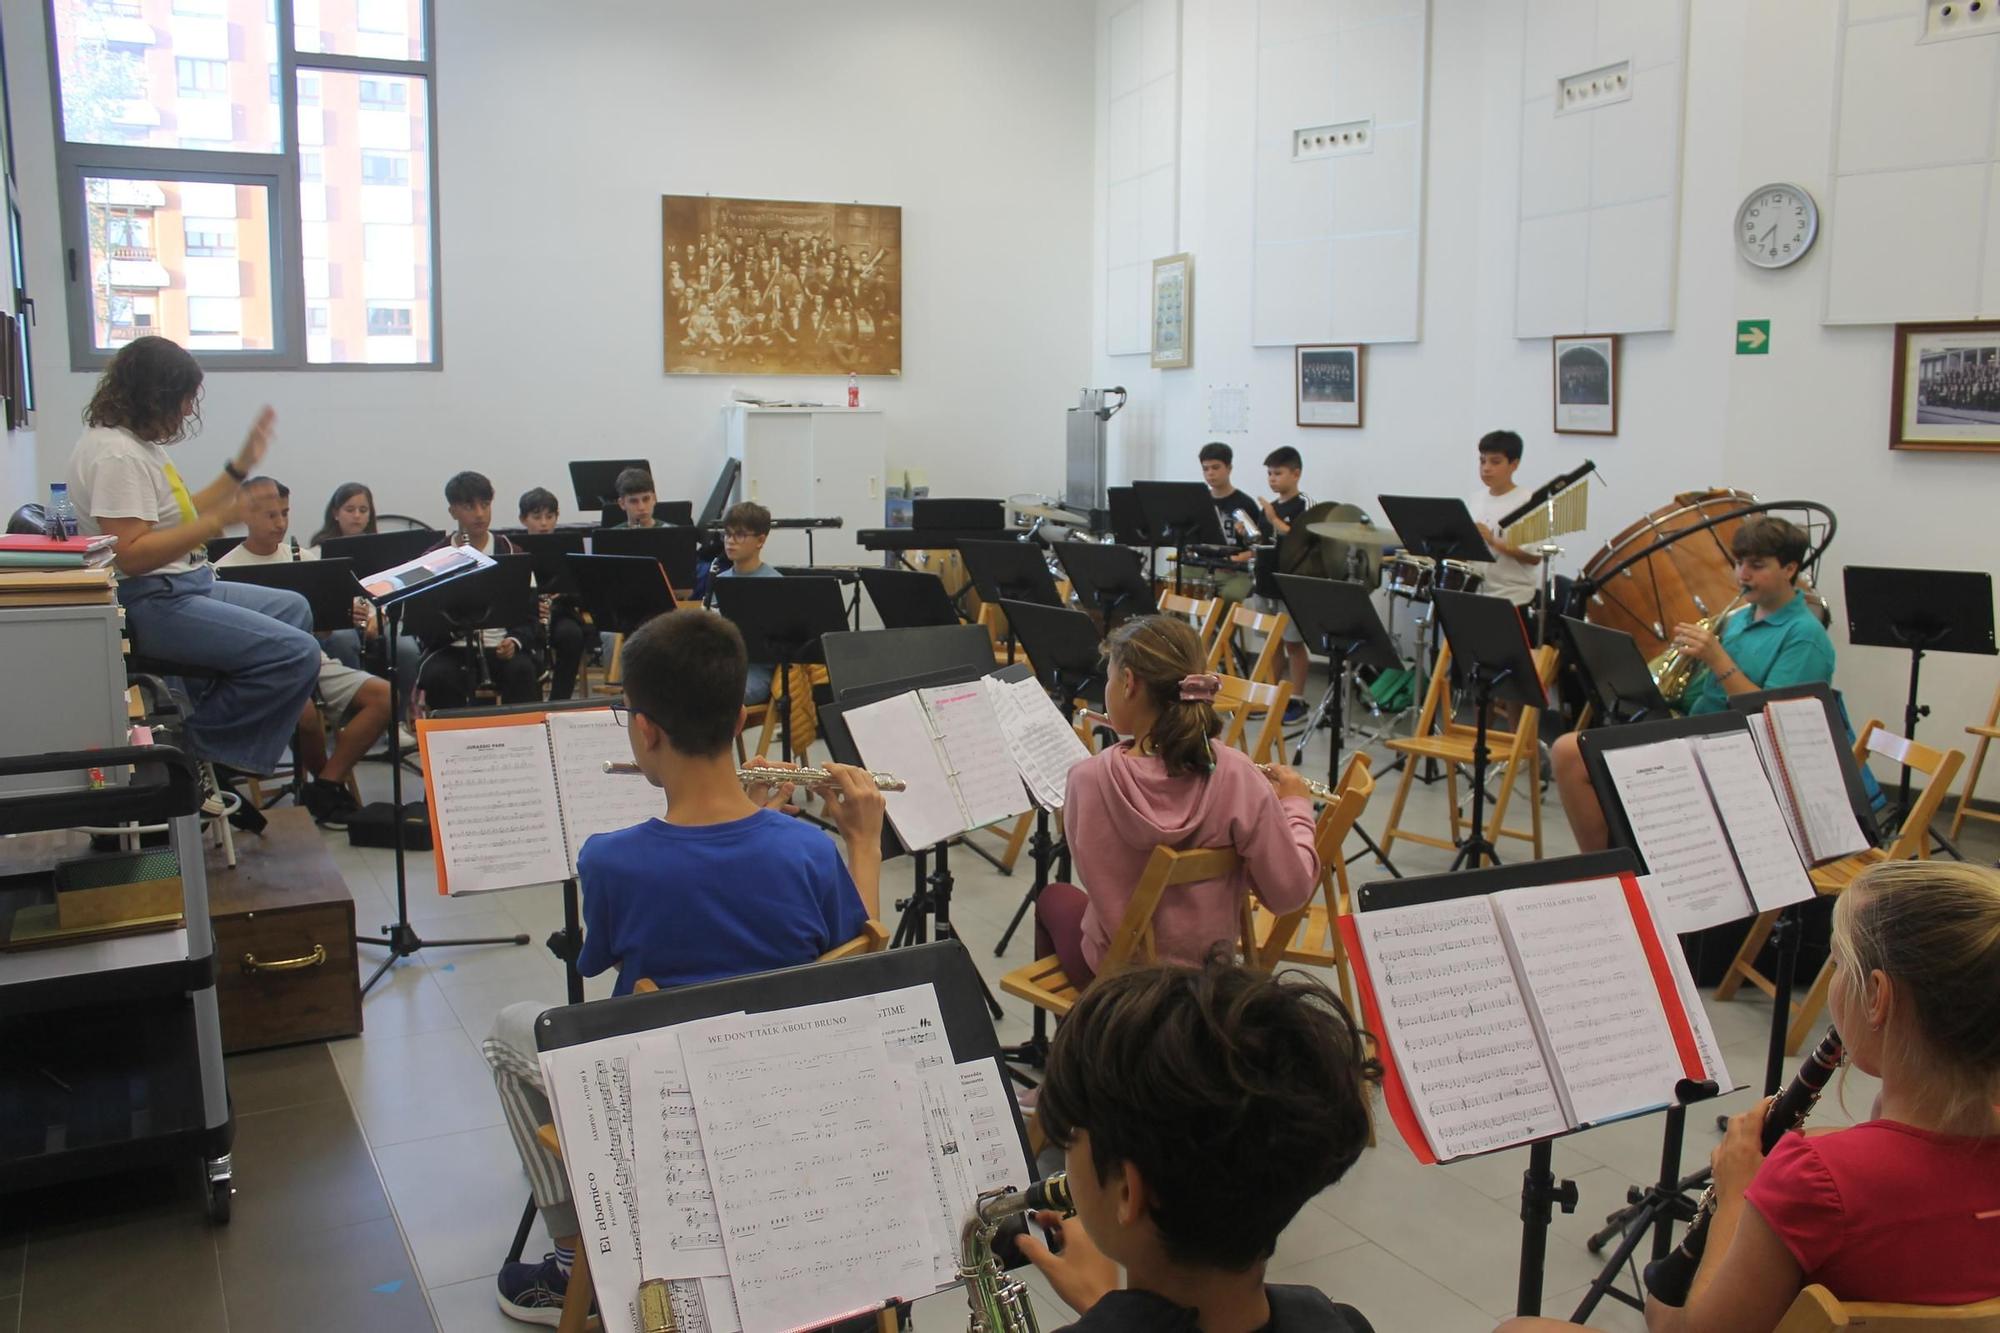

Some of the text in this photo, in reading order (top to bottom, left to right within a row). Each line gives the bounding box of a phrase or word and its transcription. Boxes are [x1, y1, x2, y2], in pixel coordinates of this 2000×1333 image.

[1761, 199, 1768, 207] 11
[1772, 193, 1782, 203] 12
[1750, 208, 1760, 217] 10
[1795, 206, 1803, 215] 2
[1746, 222, 1754, 231] 9
[1797, 219, 1805, 229] 3
[1748, 234, 1757, 244] 8
[1792, 233, 1801, 242] 4
[1758, 243, 1766, 253] 7
[1769, 247, 1778, 257] 6
[1783, 243, 1792, 253] 5
[708, 1034, 723, 1044] WE
[724, 1030, 753, 1042] DON'T
[755, 1026, 780, 1037] TALK
[781, 1021, 813, 1033] ABOUT
[814, 1016, 847, 1028] BRUNO
[587, 1172, 611, 1255] El abanico
